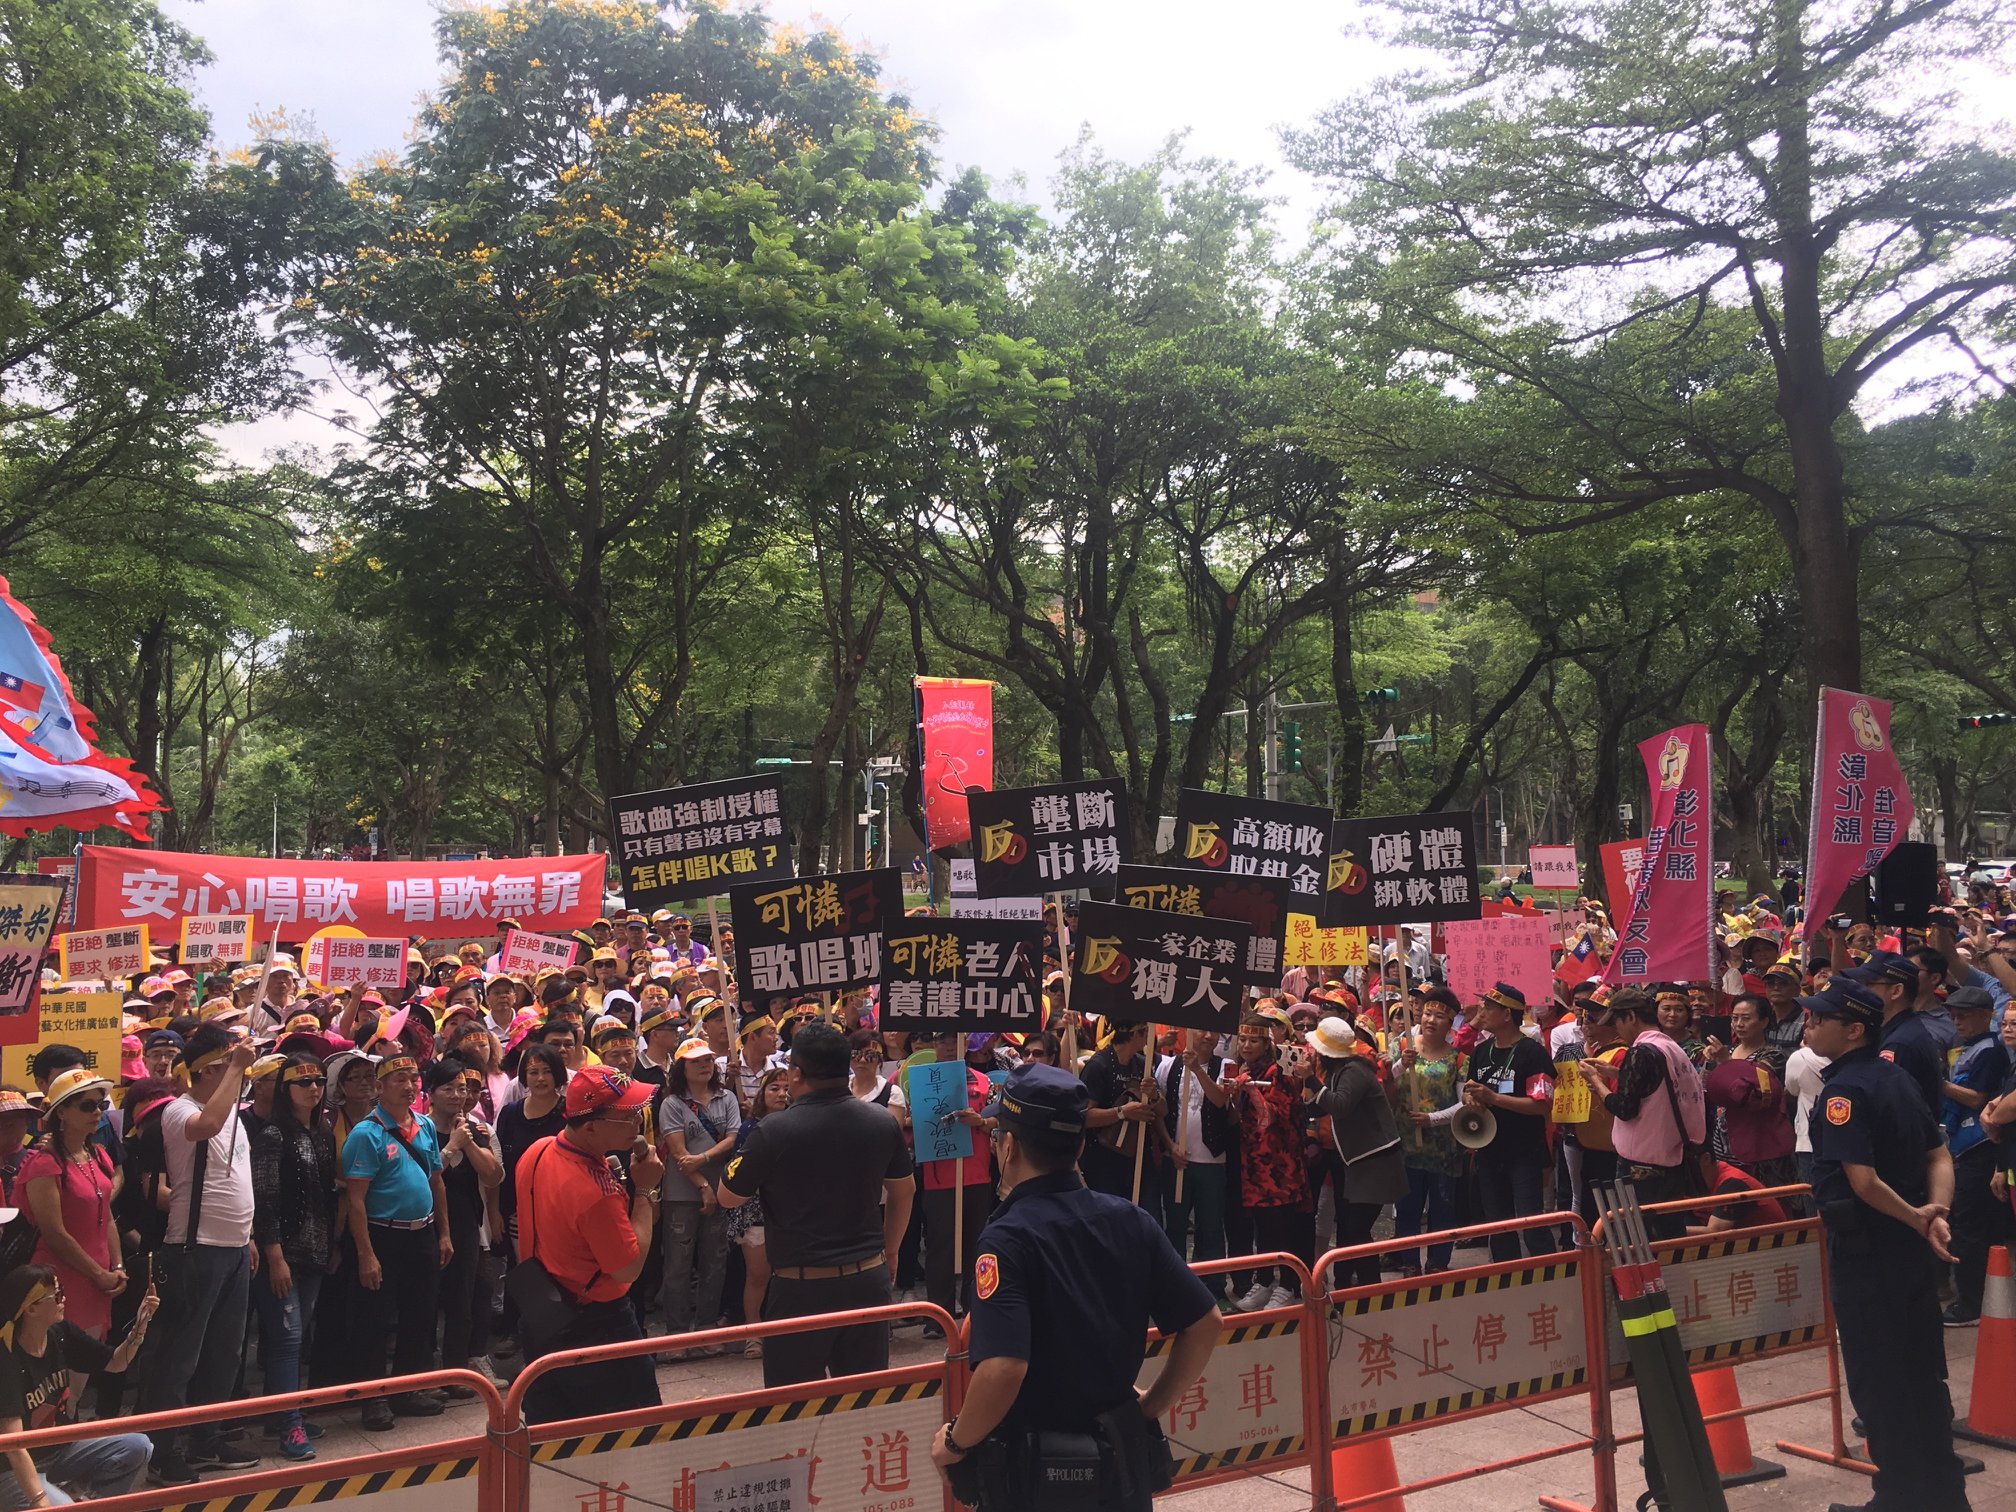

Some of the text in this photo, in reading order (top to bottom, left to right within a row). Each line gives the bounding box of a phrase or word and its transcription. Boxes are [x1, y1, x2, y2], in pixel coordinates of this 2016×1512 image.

[619, 788, 779, 837] 歌曲強制授權
[1030, 789, 1117, 836] 壟斷
[1664, 788, 1699, 881] 彰化縣
[623, 817, 783, 860] 只有聲音沒有字幕
[1035, 834, 1121, 881] 市場
[1231, 816, 1325, 858] 高額收
[1368, 826, 1466, 875] 硬體
[120, 868, 360, 924] 安心唱歌
[386, 871, 582, 922] 唱歌無罪
[953, 870, 977, 881] 唱歌
[1373, 875, 1471, 908] 綁軟體
[754, 880, 845, 934] 可憐
[1137, 932, 1237, 964] 一家企業
[888, 980, 1035, 1018] 養護中心
[1131, 957, 1230, 1012] 獨大
[39, 1016, 119, 1033] 藝文化推廣協會
[41, 1001, 87, 1014] 中華民國
[1357, 1303, 1562, 1388] 禁止停車
[1239, 1424, 1280, 1440] 105-064
